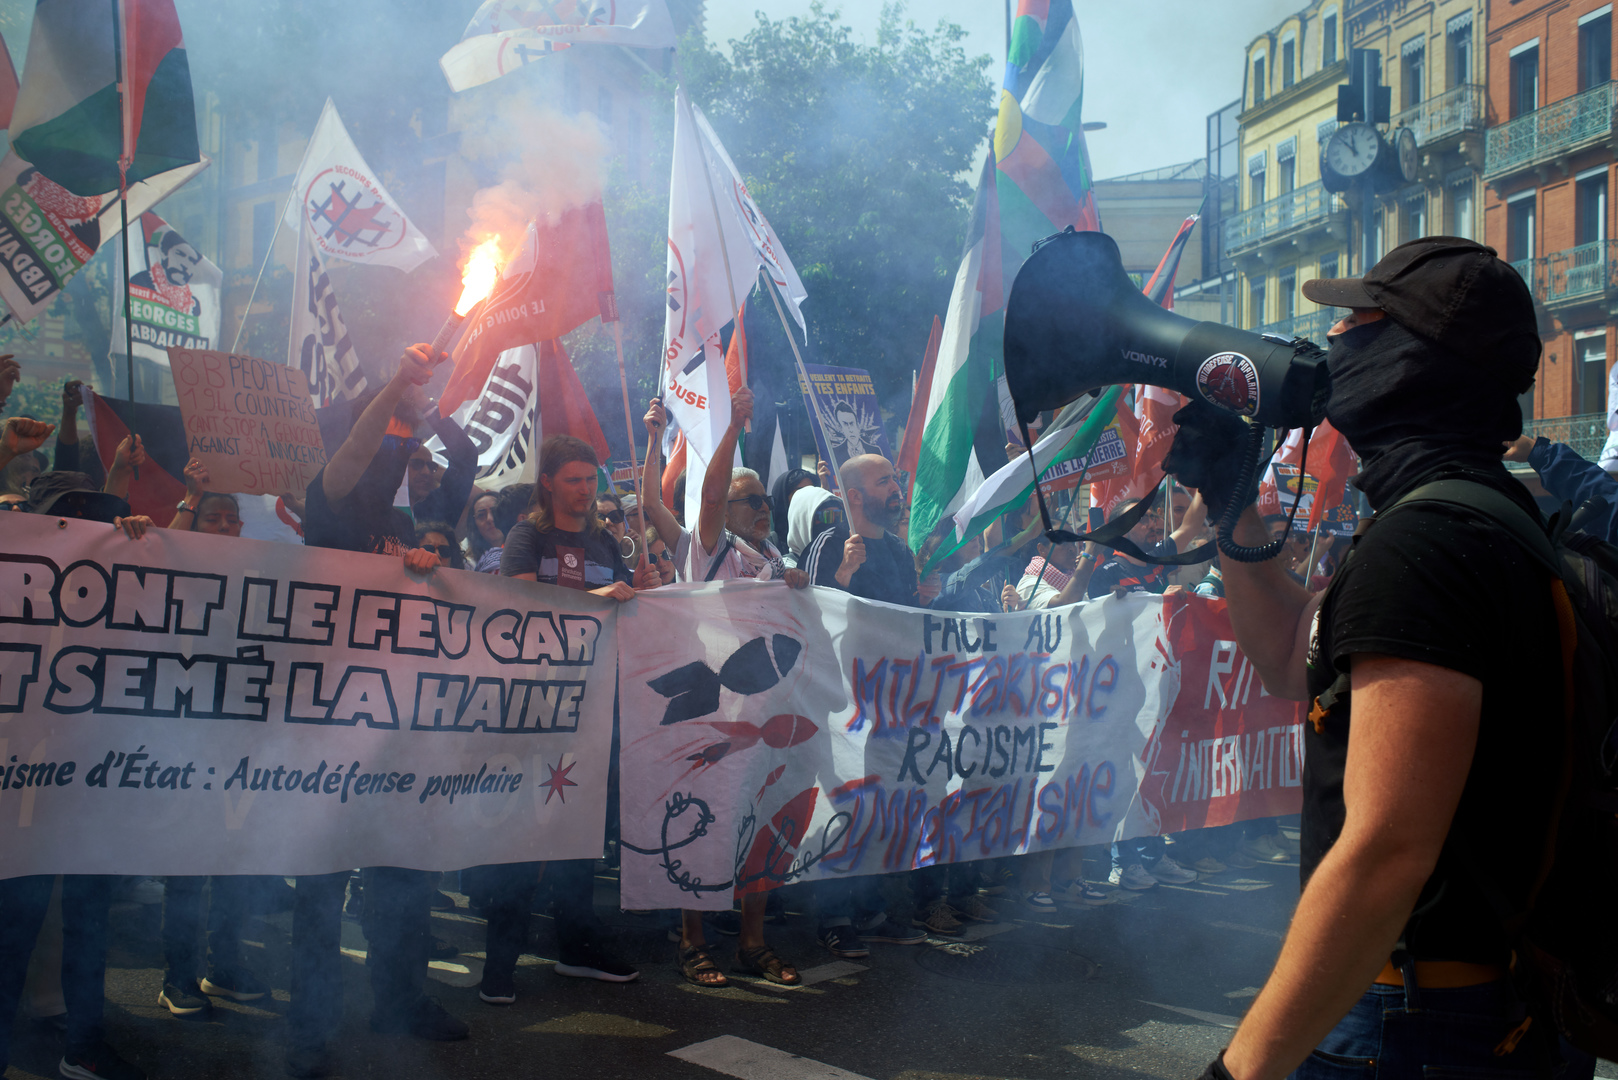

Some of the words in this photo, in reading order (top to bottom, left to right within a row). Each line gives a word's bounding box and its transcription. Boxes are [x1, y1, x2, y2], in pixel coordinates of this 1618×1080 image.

[335, 165, 371, 189] SECOURS
[130, 300, 194, 332] EORGES
[1121, 349, 1168, 369] VONYX
[183, 388, 232, 415] 194
[814, 383, 835, 395] TES
[835, 383, 876, 395] ENFANTS
[222, 416, 256, 437] STOP
[261, 421, 269, 438] A
[274, 422, 323, 448] GENOCIDE
[190, 435, 240, 455] AGAINST
[268, 440, 327, 465] INNOCENTS
[238, 460, 310, 491] SHAME
[237, 576, 341, 646] LE
[348, 588, 476, 660] FEU
[482, 608, 602, 666] CAR
[923, 614, 998, 654] FACE
[1024, 614, 1062, 653] AU
[43, 645, 275, 722] SEMÉ
[284, 661, 400, 730] LA
[410, 672, 586, 734] HAINE
[897, 722, 1058, 785] RACISME
[224, 756, 416, 804] Autodéfense
[418, 762, 523, 804] populaire
